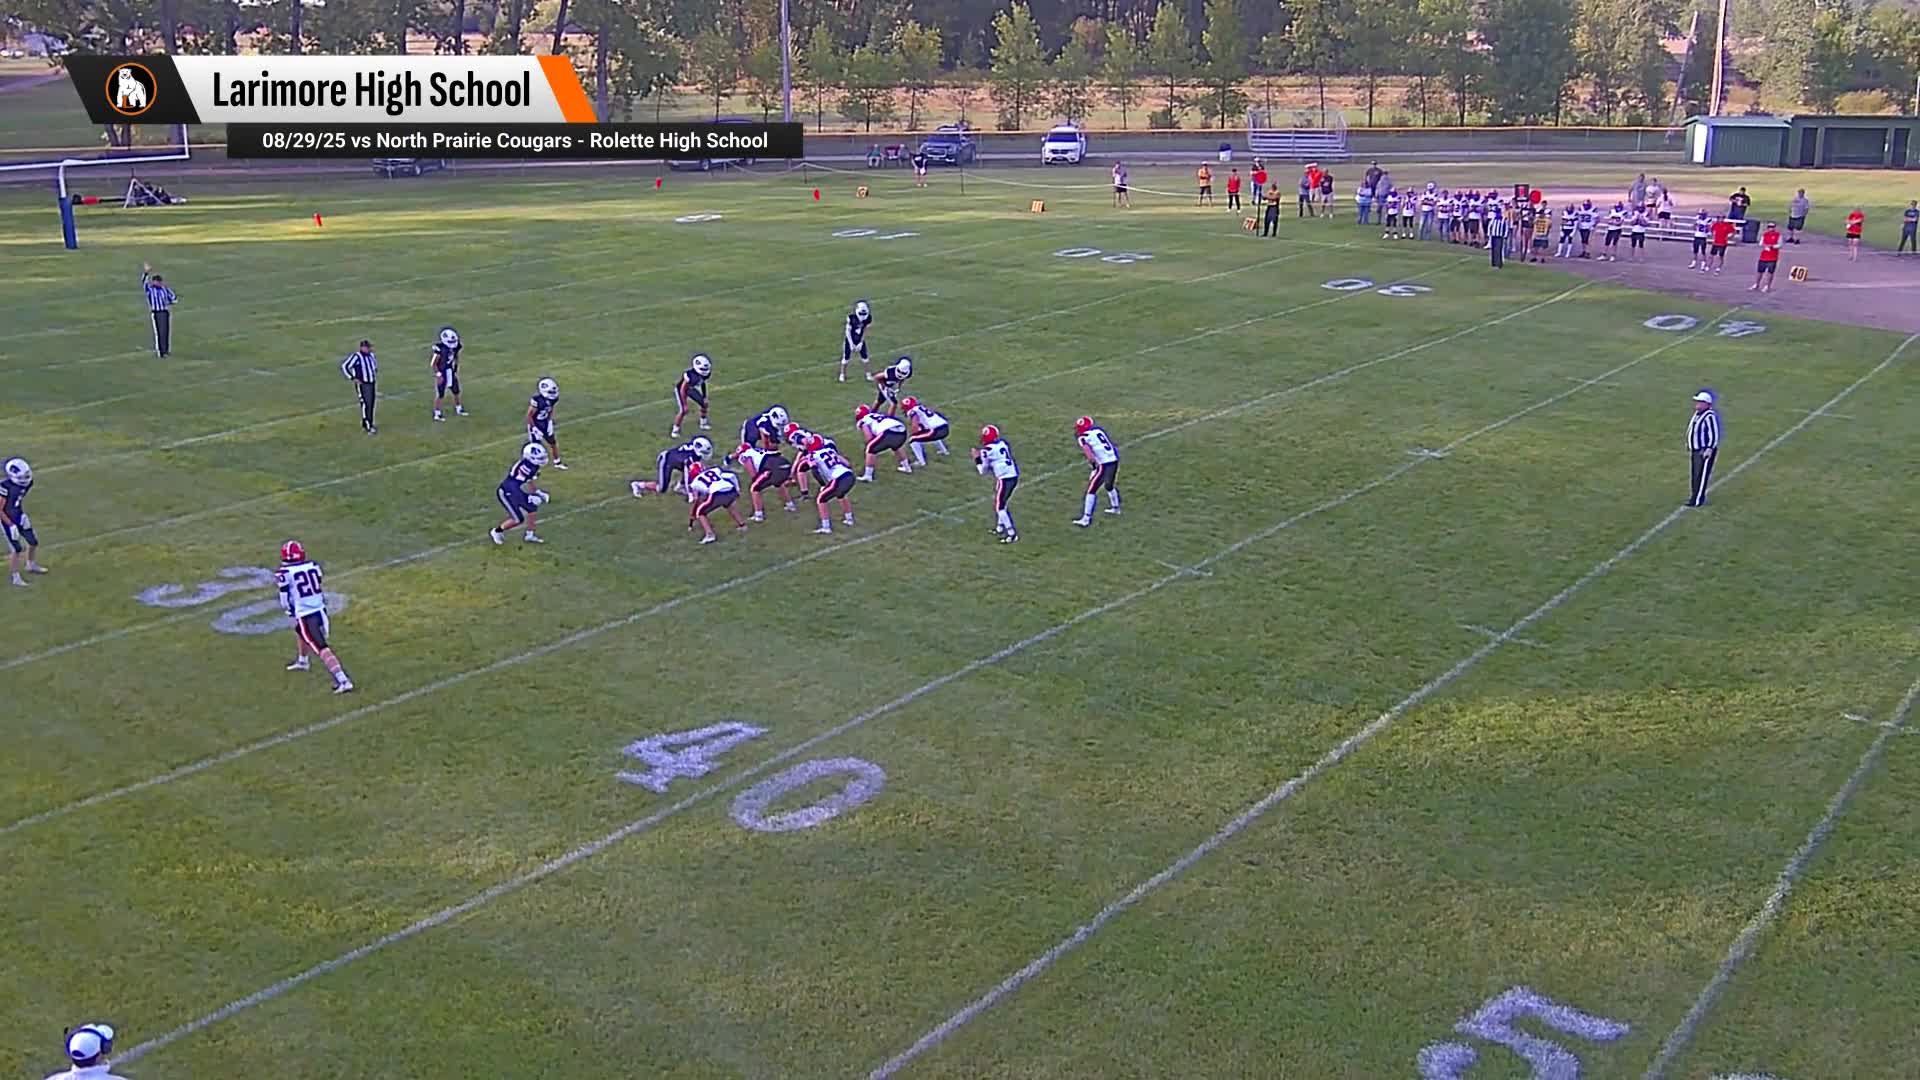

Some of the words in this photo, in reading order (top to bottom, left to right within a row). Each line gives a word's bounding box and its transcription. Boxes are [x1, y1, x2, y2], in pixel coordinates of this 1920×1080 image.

[1790, 267, 1804, 280] 40
[1096, 432, 1112, 451] 9
[999, 447, 1012, 466] 3
[697, 470, 722, 488] 18
[293, 568, 323, 599] 20
[615, 720, 887, 832] 40
